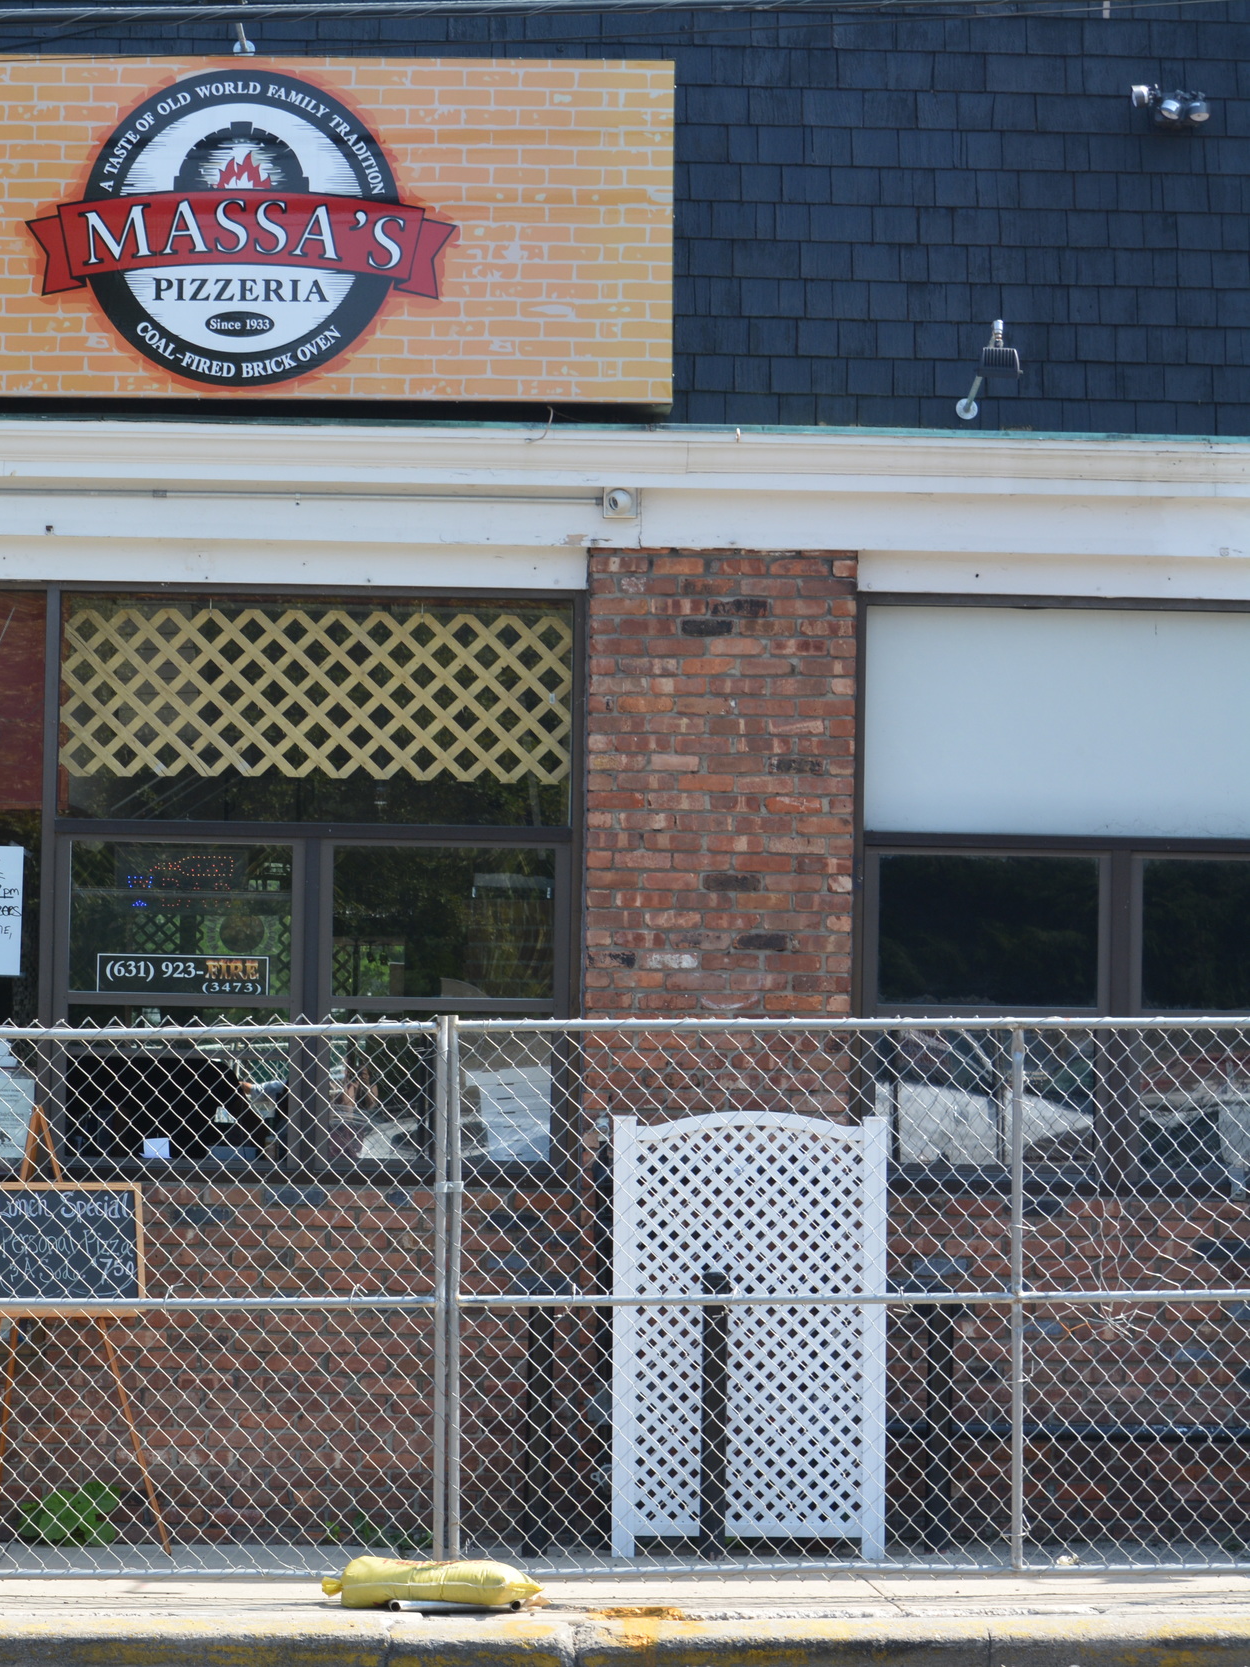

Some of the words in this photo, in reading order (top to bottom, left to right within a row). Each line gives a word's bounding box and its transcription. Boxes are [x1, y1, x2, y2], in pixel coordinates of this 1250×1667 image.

[194, 81, 261, 99] WORLD
[266, 84, 330, 118] FAMILY
[157, 92, 191, 115] OLD
[135, 111, 155, 131] OF
[103, 130, 140, 175] TASTE
[328, 115, 385, 194] TRADITION
[99, 180, 114, 192] A
[81, 198, 408, 271] MASSA'S
[152, 277, 330, 303] PIZZERIA
[209, 318, 241, 330] Since
[245, 318, 270, 330] 1933
[136, 321, 236, 378] COAL-FIRED
[241, 353, 298, 378] BRICK
[296, 324, 342, 362] OVEN
[105, 960, 155, 982] (631)
[161, 959, 260, 981] 923-FIRE
[201, 982, 262, 995] (3473)
[60, 1191, 129, 1224] Special
[1, 1227, 76, 1258] Personal
[83, 1229, 134, 1258] Pizza
